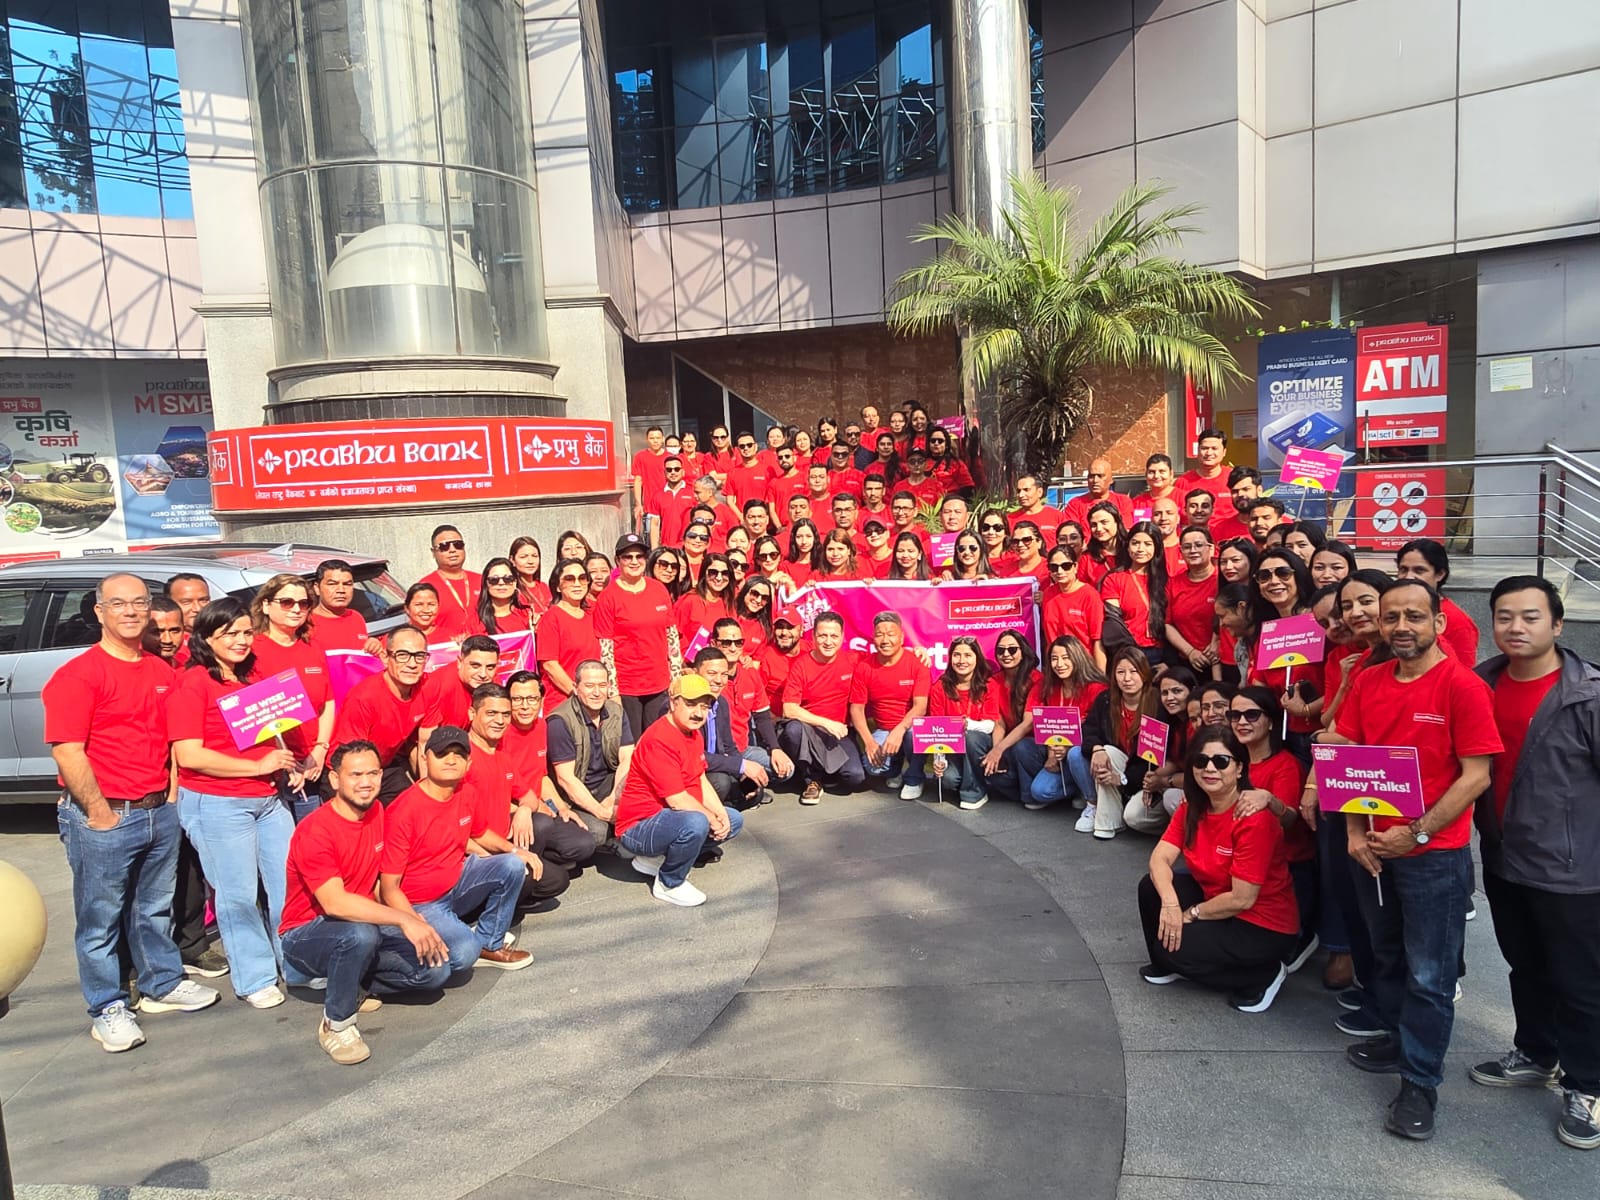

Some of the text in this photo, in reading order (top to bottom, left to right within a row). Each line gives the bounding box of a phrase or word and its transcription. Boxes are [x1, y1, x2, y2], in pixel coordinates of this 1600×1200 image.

[1362, 354, 1440, 393] ATM
[1269, 375, 1344, 396] OPTIMIZE
[1270, 389, 1344, 403] YOUR BUSINESS
[1270, 399, 1344, 416] EXPENSES
[13, 409, 72, 441] कृषि
[38, 430, 79, 447] कर्जा
[552, 432, 604, 465] प्रभु बैंक
[947, 620, 1025, 631] www.prabhubank.com
[244, 703, 260, 715] BE
[932, 725, 945, 733] No
[1344, 767, 1387, 780] Smart
[1325, 778, 1411, 795] Money Talks!
